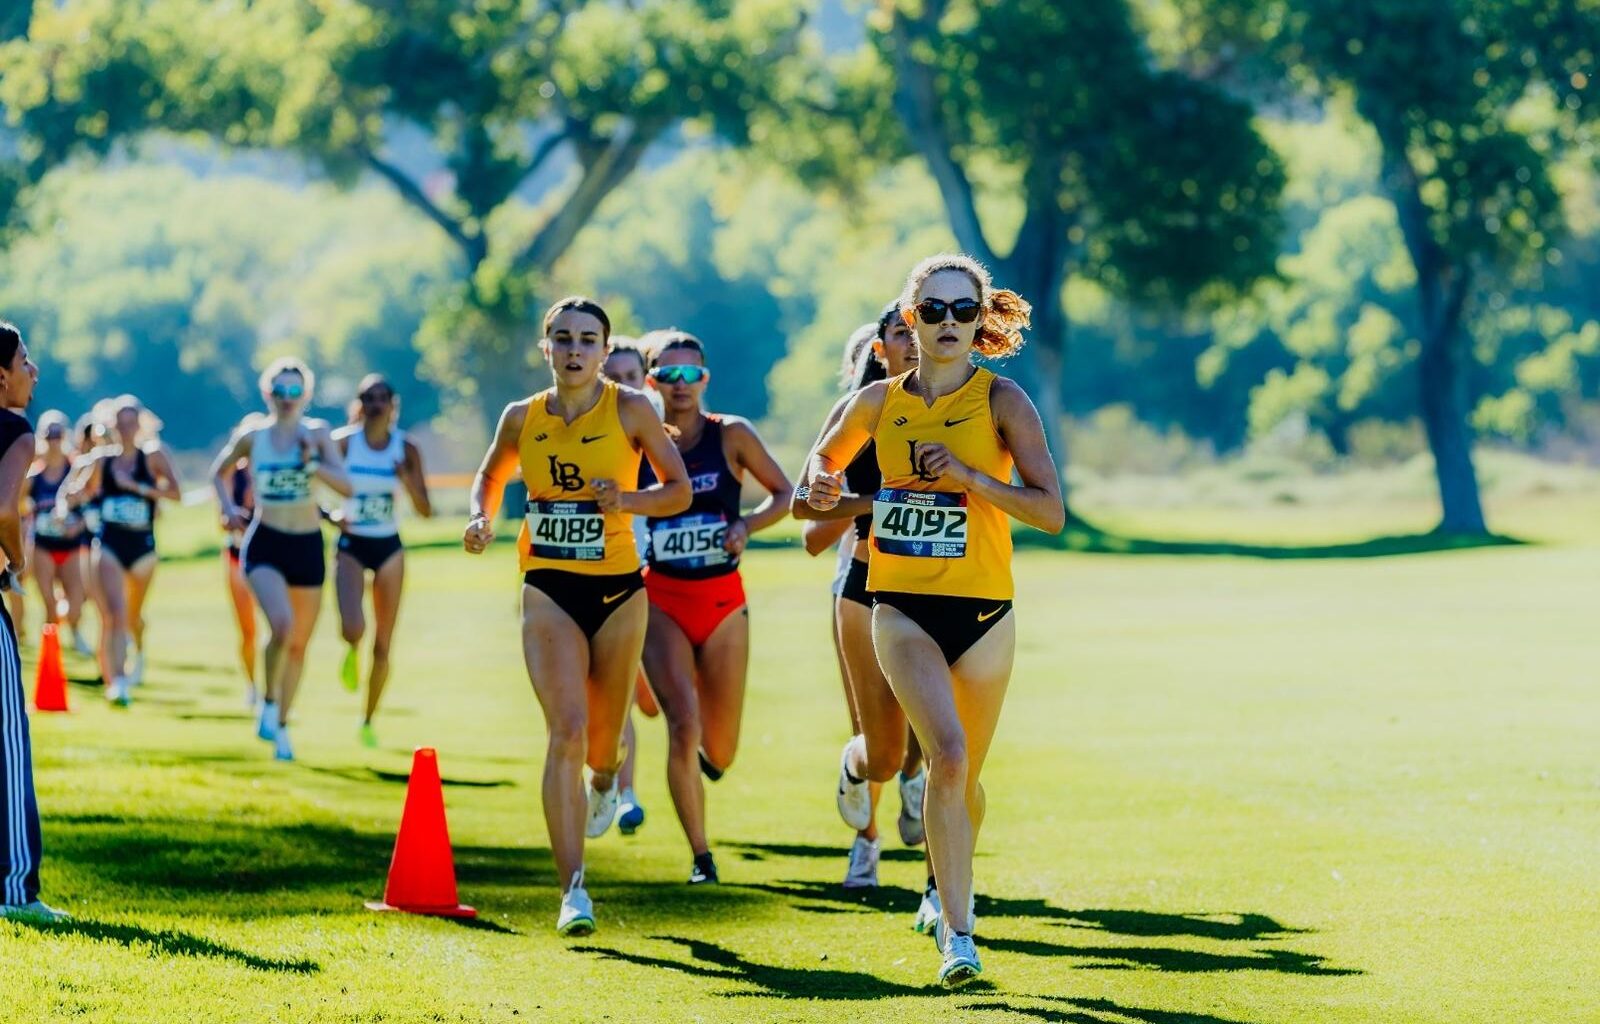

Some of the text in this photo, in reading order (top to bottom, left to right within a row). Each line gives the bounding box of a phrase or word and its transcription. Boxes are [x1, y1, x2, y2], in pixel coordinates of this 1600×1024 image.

[547, 455, 585, 492] LB
[536, 518, 605, 543] 4089
[882, 506, 967, 538] 4092
[663, 527, 727, 554] 4056
